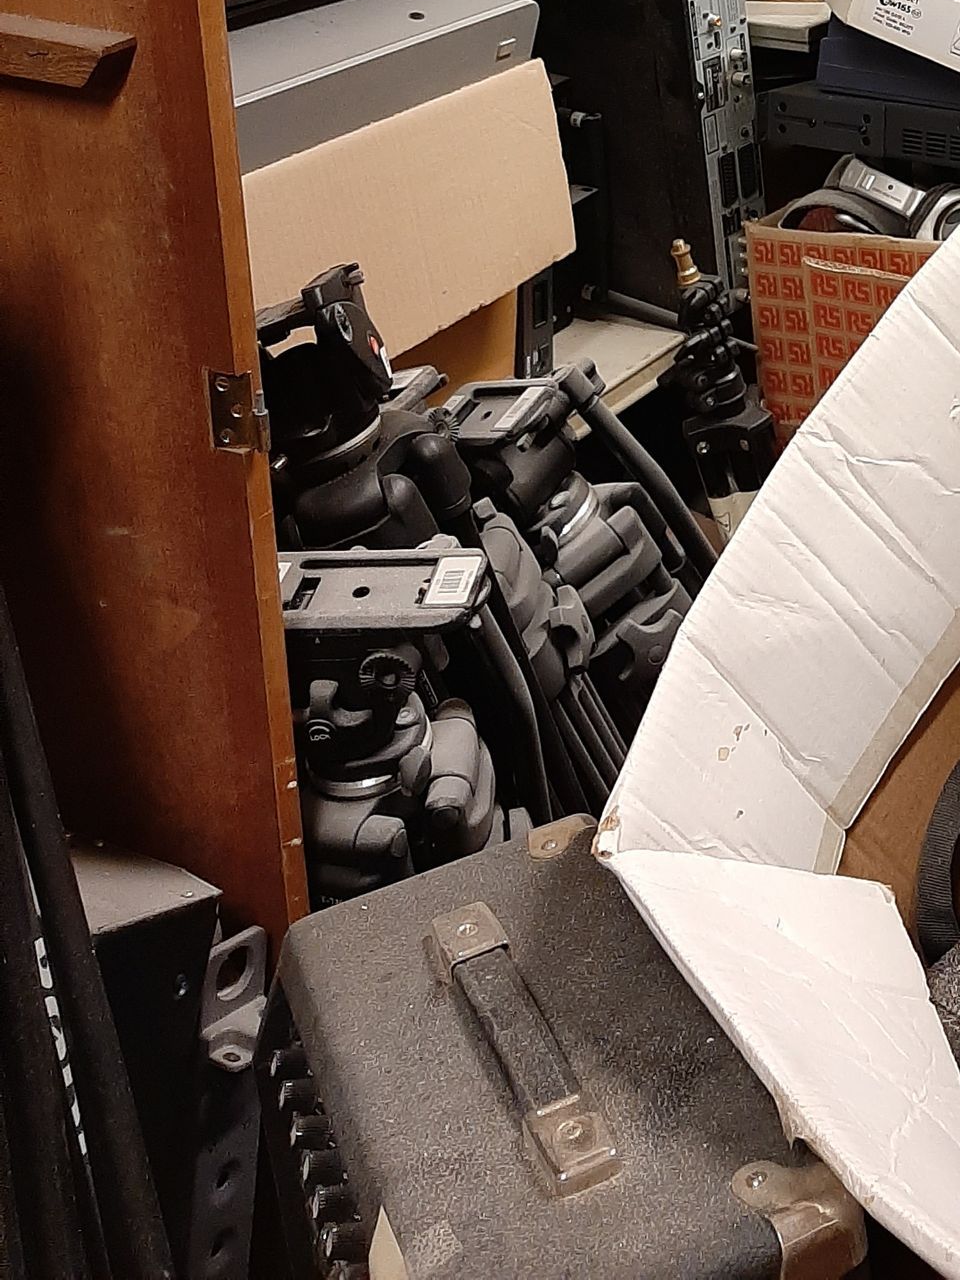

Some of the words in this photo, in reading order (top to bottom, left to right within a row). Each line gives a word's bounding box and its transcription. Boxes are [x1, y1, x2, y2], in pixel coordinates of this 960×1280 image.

[811, 272, 839, 297] RS
[844, 279, 870, 304] RS
[814, 303, 841, 328] RS
